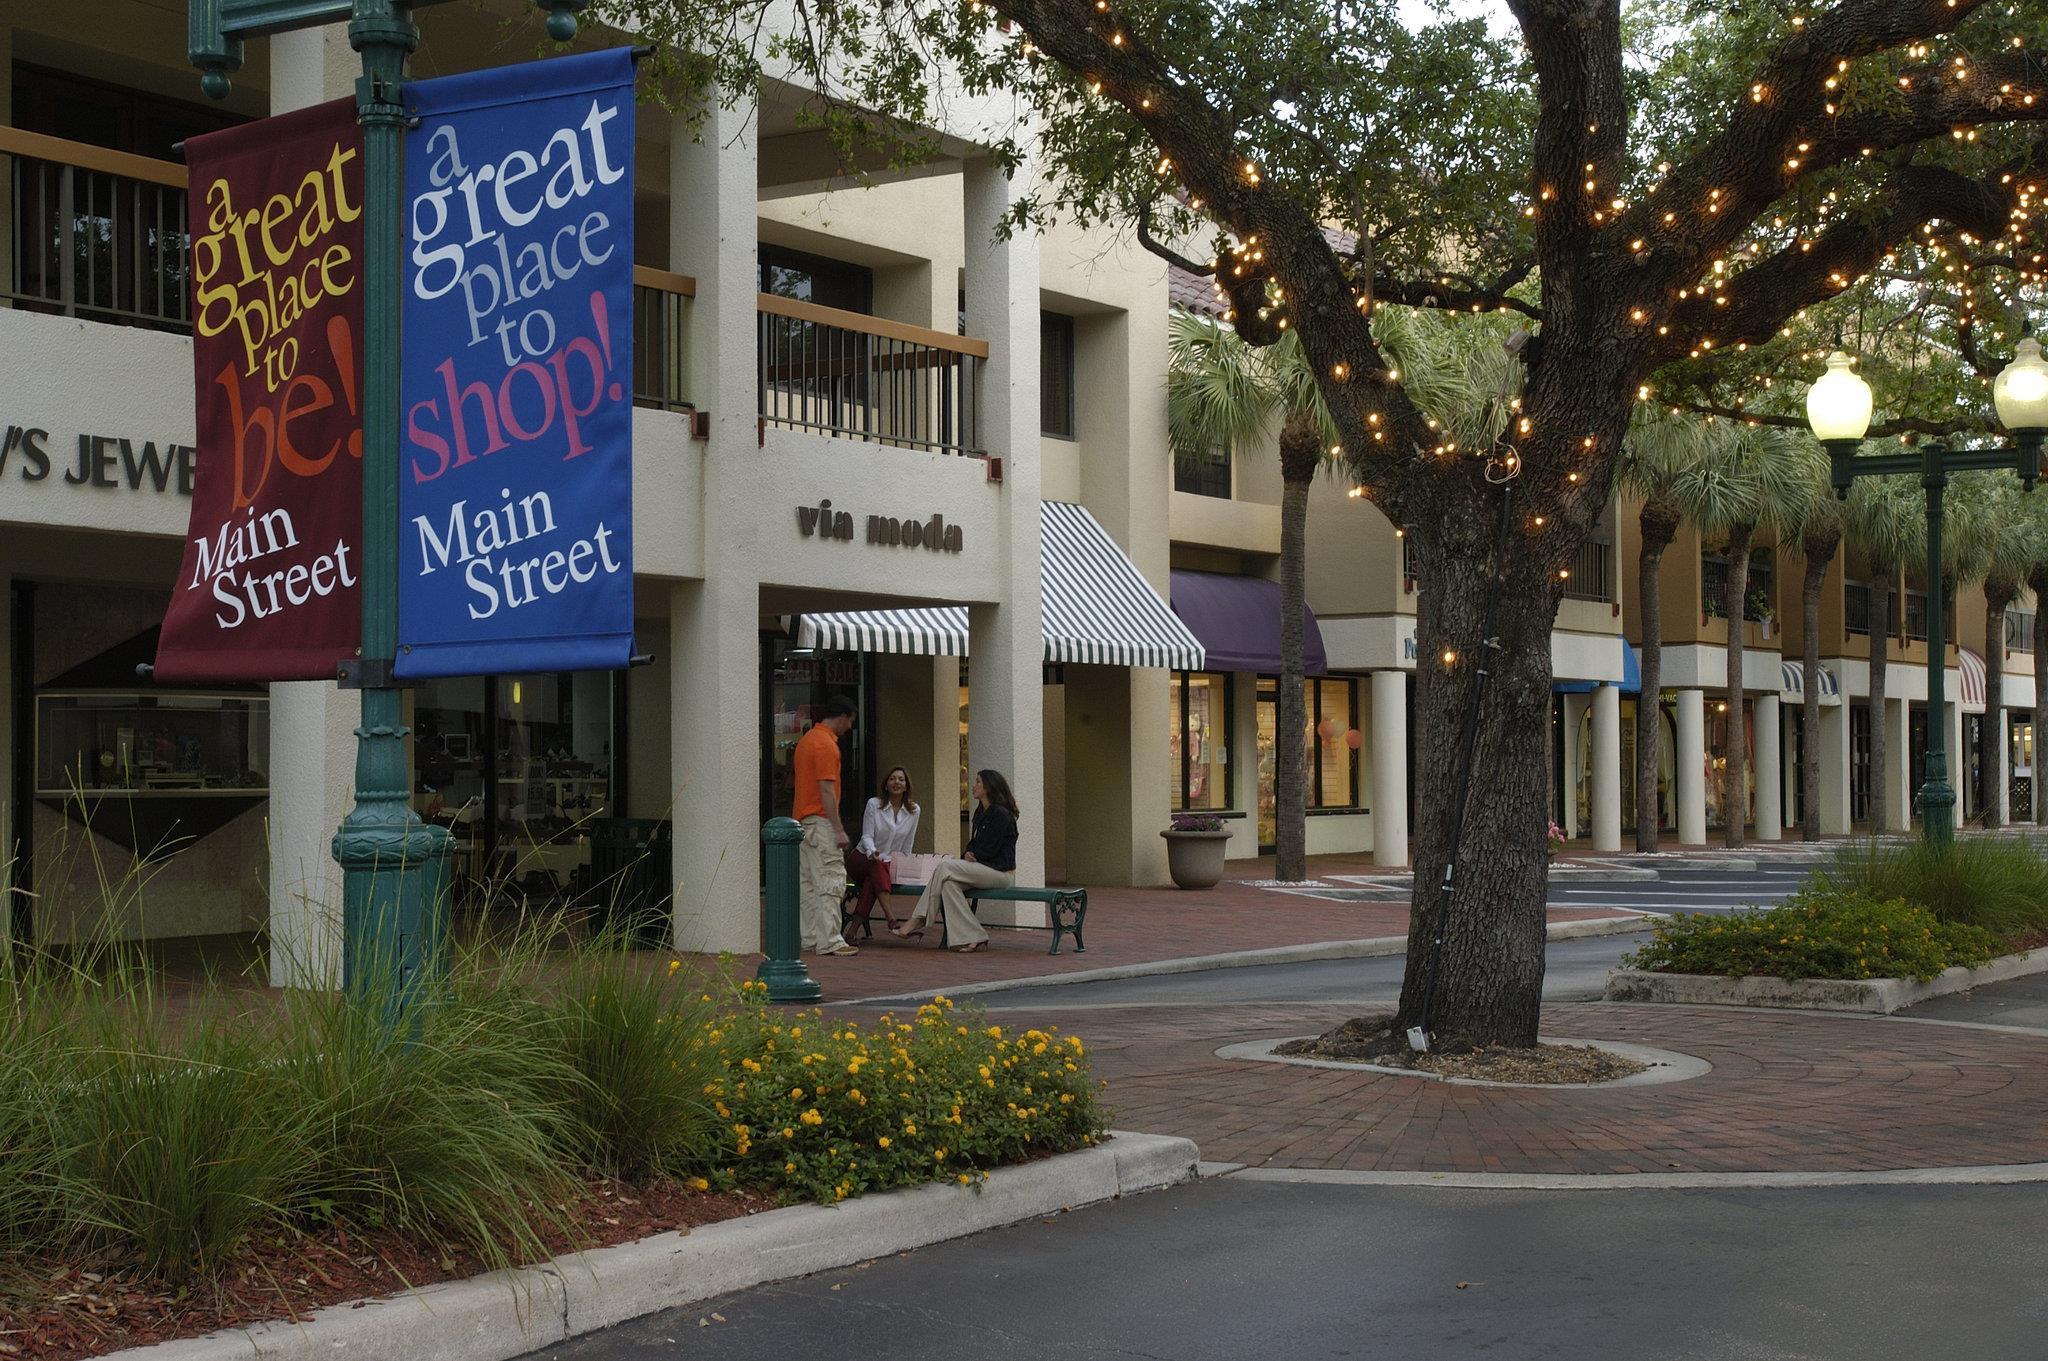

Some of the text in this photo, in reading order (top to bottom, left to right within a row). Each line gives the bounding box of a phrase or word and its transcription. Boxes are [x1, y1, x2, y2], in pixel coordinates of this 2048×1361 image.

[412, 99, 625, 300] great
[427, 125, 469, 187] a
[194, 141, 362, 337] great
[206, 178, 238, 233] a
[233, 244, 355, 378] place
[458, 211, 615, 347] place
[263, 336, 299, 393] to
[494, 309, 556, 367] to
[214, 314, 363, 512] be!
[407, 290, 623, 485] shop!
[187, 505, 300, 590] Main
[412, 487, 558, 576] Main
[464, 521, 622, 620] Street
[796, 498, 964, 552] via moda
[212, 537, 357, 629] Street
